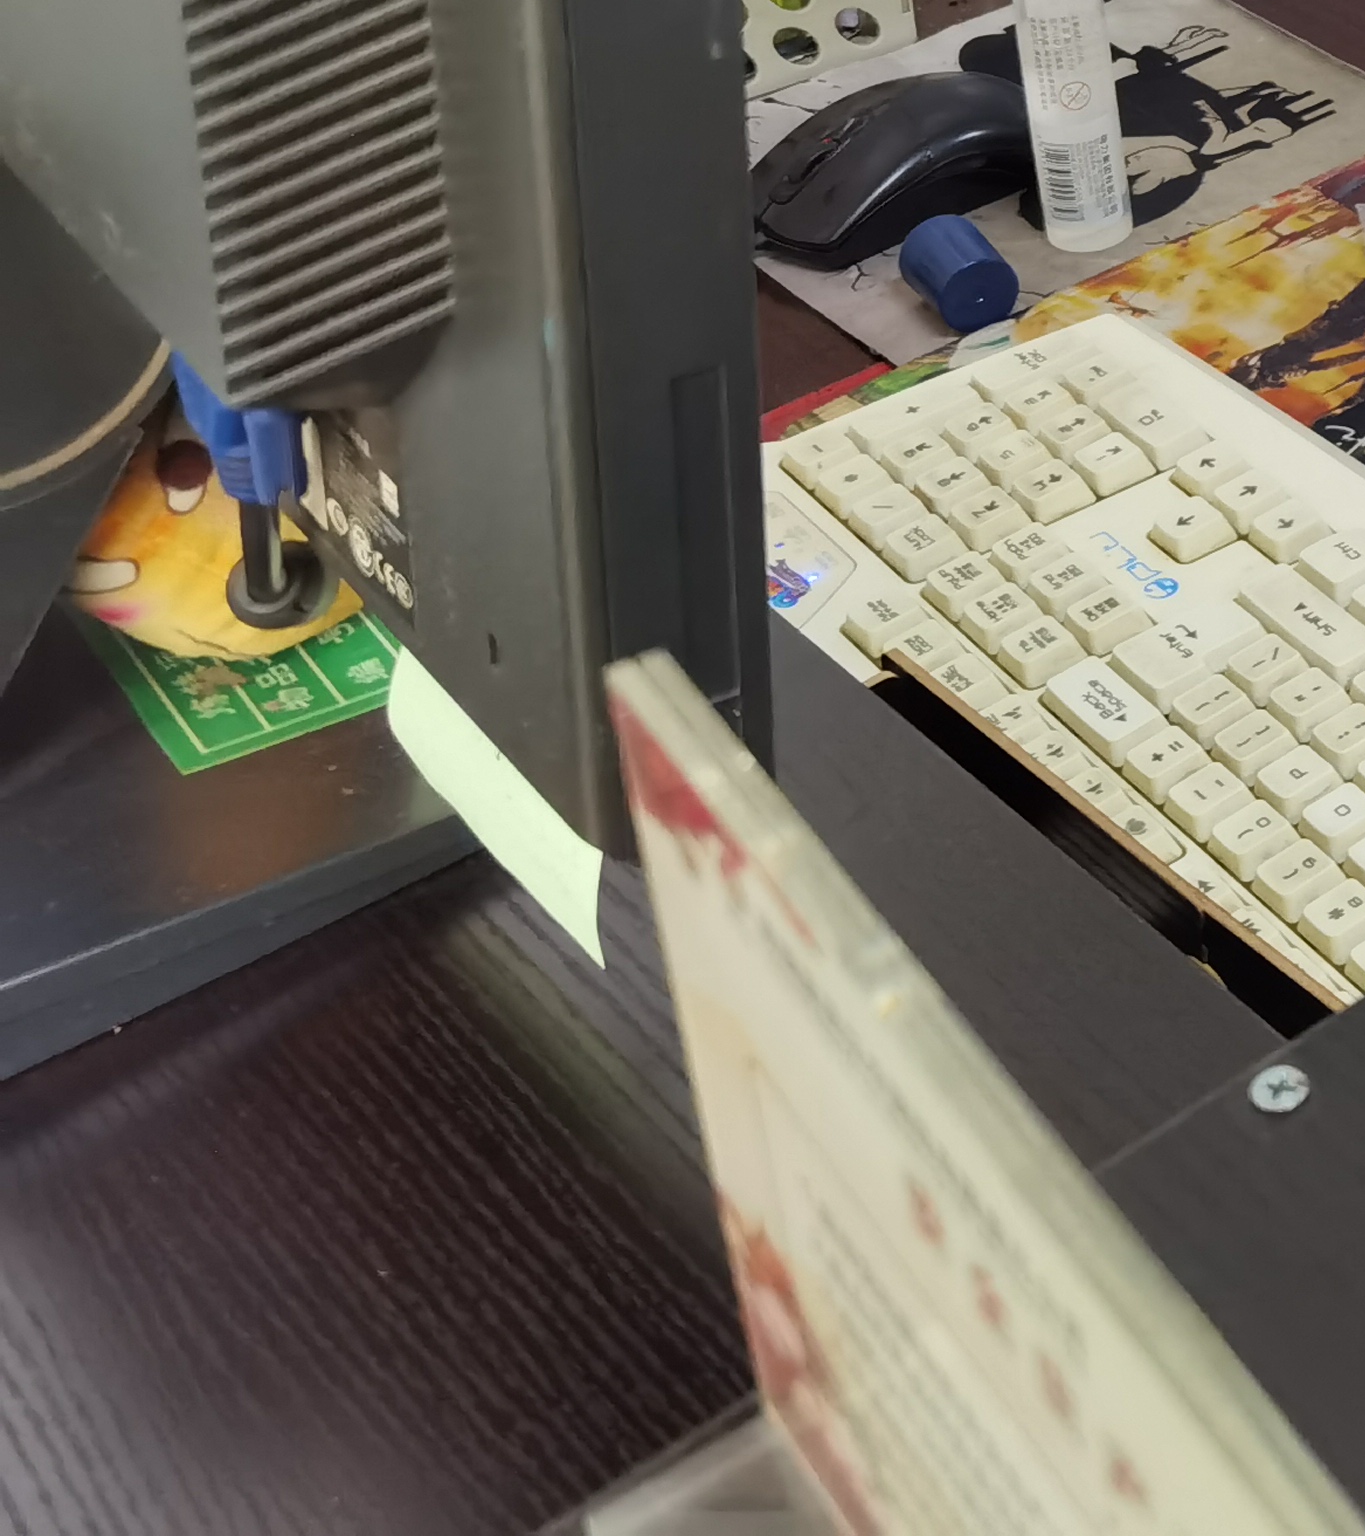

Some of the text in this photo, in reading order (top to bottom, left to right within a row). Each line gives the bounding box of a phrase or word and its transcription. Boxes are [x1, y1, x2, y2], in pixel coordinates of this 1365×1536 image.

[1081, 691, 1118, 720] Back
[1288, 768, 1309, 780] P
[1301, 856, 1317, 869] 9
[1347, 896, 1364, 909] 8
